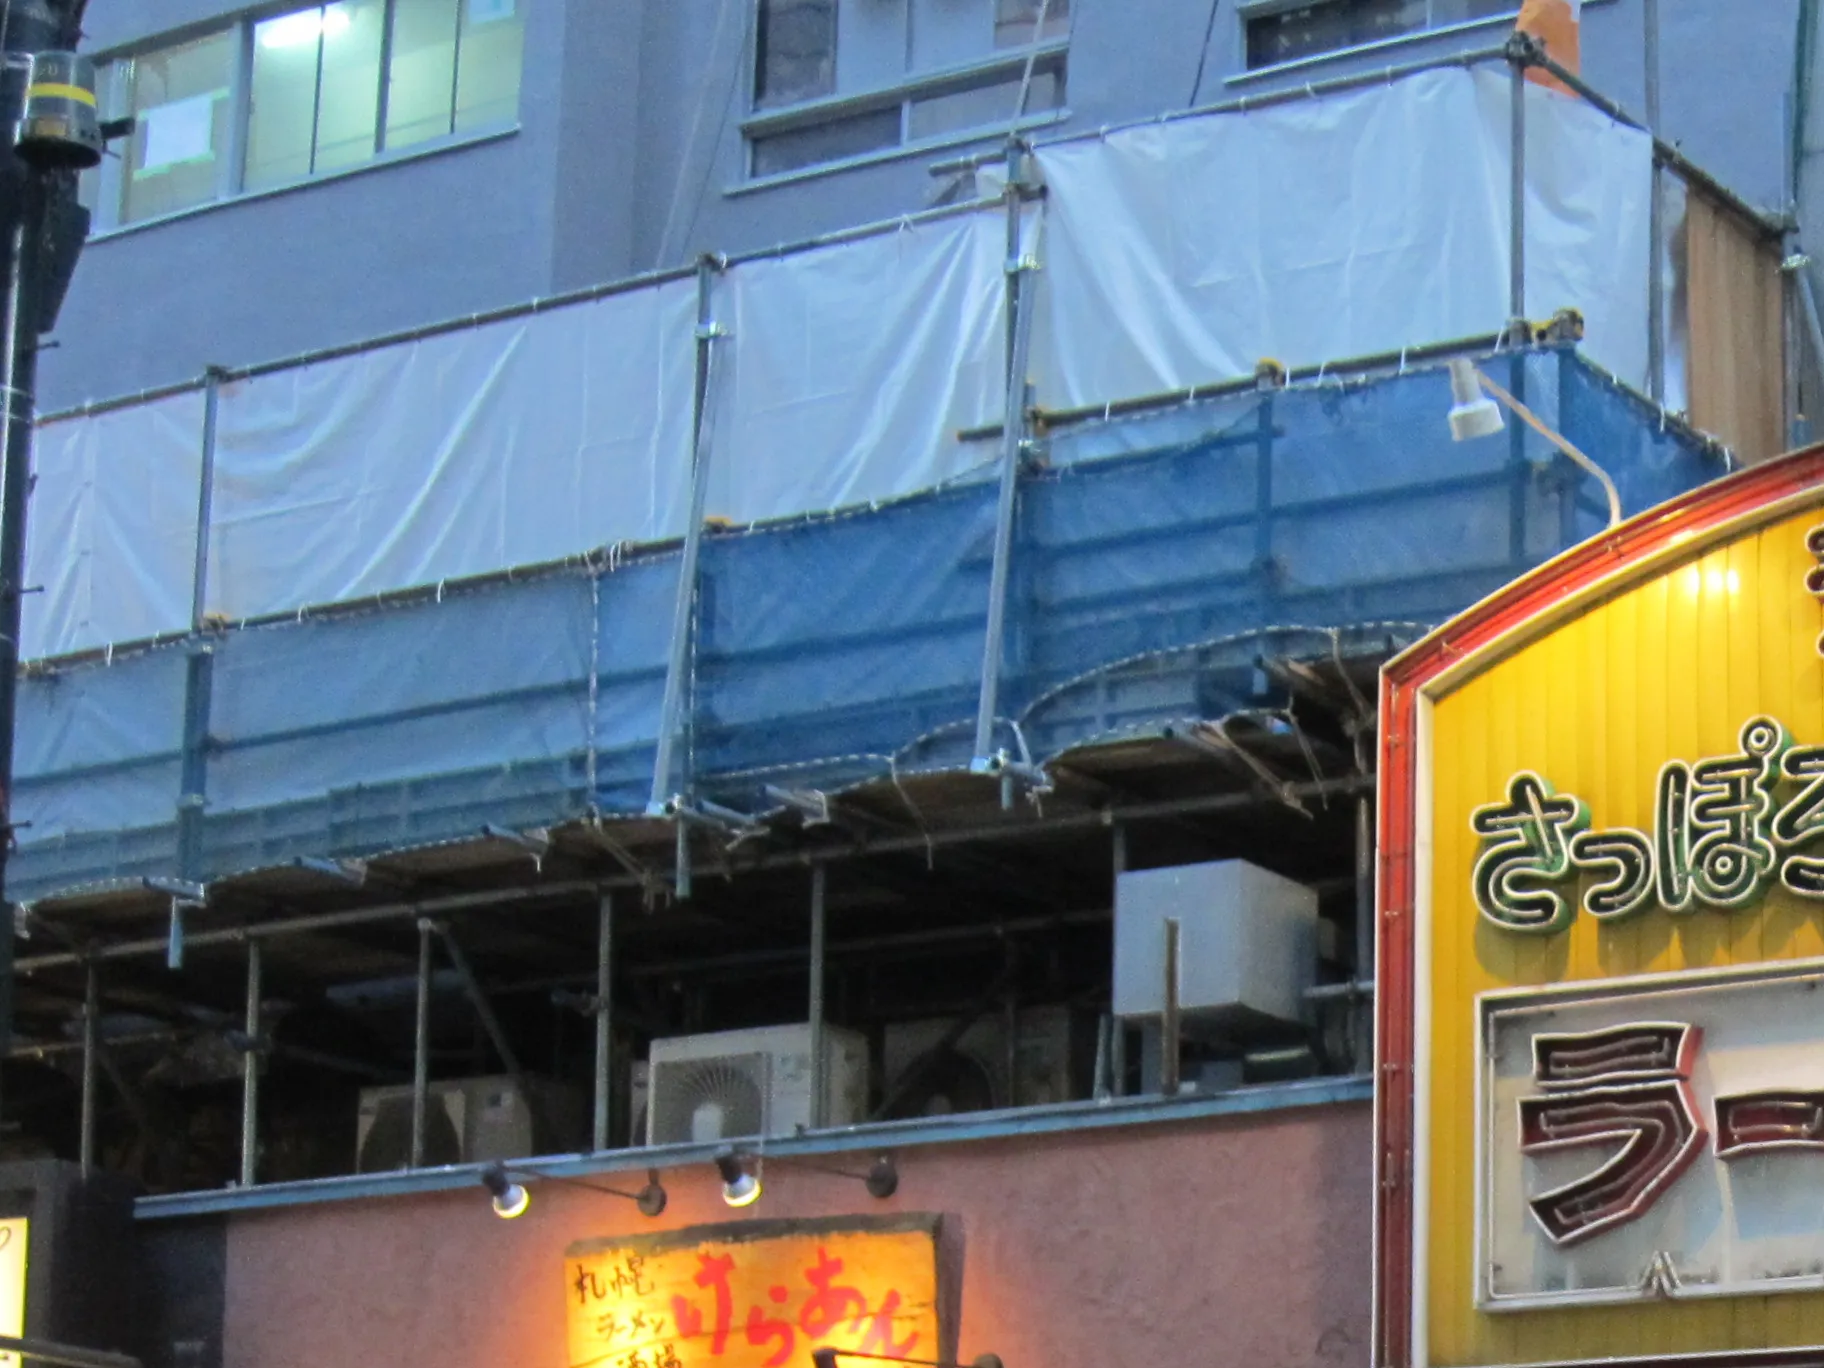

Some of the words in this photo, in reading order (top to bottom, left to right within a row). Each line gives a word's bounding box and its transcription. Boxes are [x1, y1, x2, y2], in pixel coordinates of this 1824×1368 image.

[576, 1254, 656, 1304] 札幌
[595, 1310, 666, 1342] ラーメン
